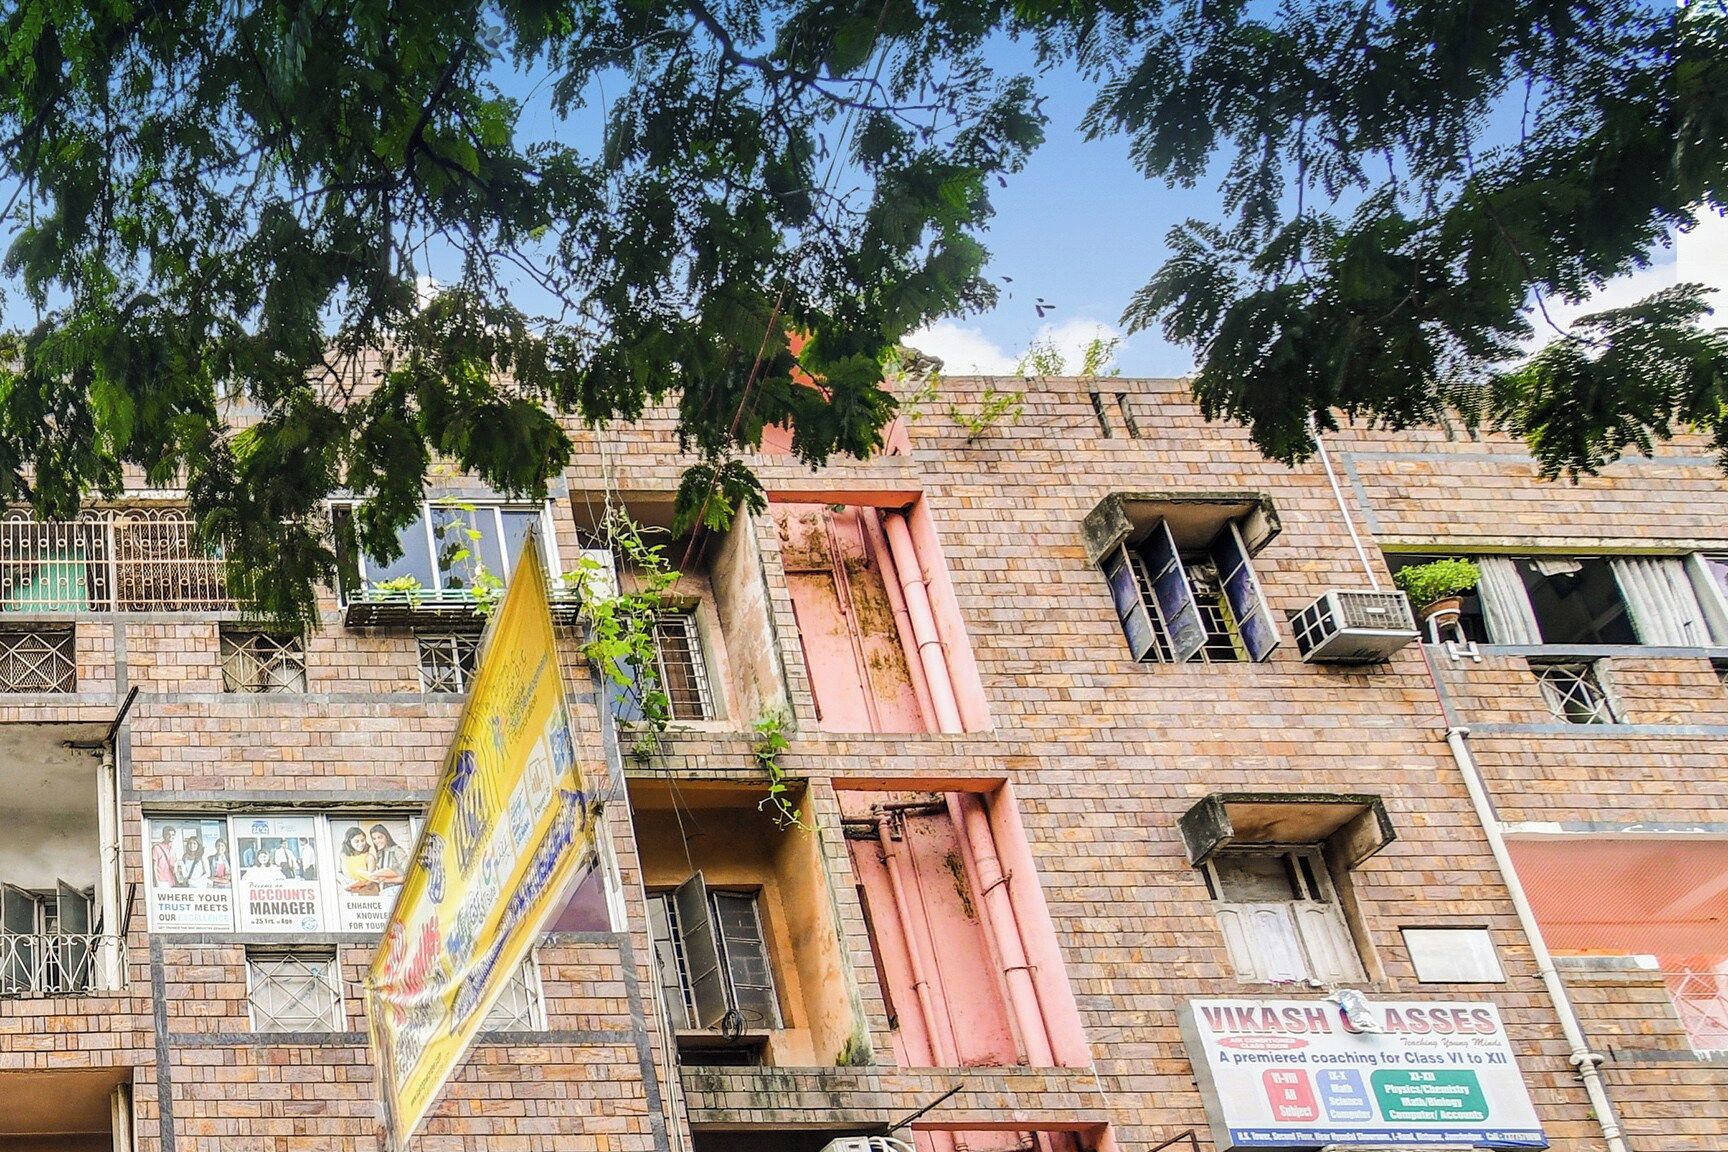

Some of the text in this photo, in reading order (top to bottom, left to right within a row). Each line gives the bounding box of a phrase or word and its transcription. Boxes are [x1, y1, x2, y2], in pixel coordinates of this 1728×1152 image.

[157, 893, 227, 902] WHERE YOUR
[249, 888, 315, 901] ACCOUNTS
[158, 903, 228, 912] TRUST MEETS
[250, 902, 315, 915] MANAGER
[347, 902, 382, 910] ENHANCE
[159, 913, 176, 922] OUR
[1200, 1005, 1330, 1035] VIKASH
[1400, 1037, 1502, 1048] Teaching Young Minds
[1220, 1050, 1508, 1066] A premiered coaching for Class VI to XII
[1329, 1097, 1364, 1106] Science
[1279, 1105, 1313, 1118] Subject
